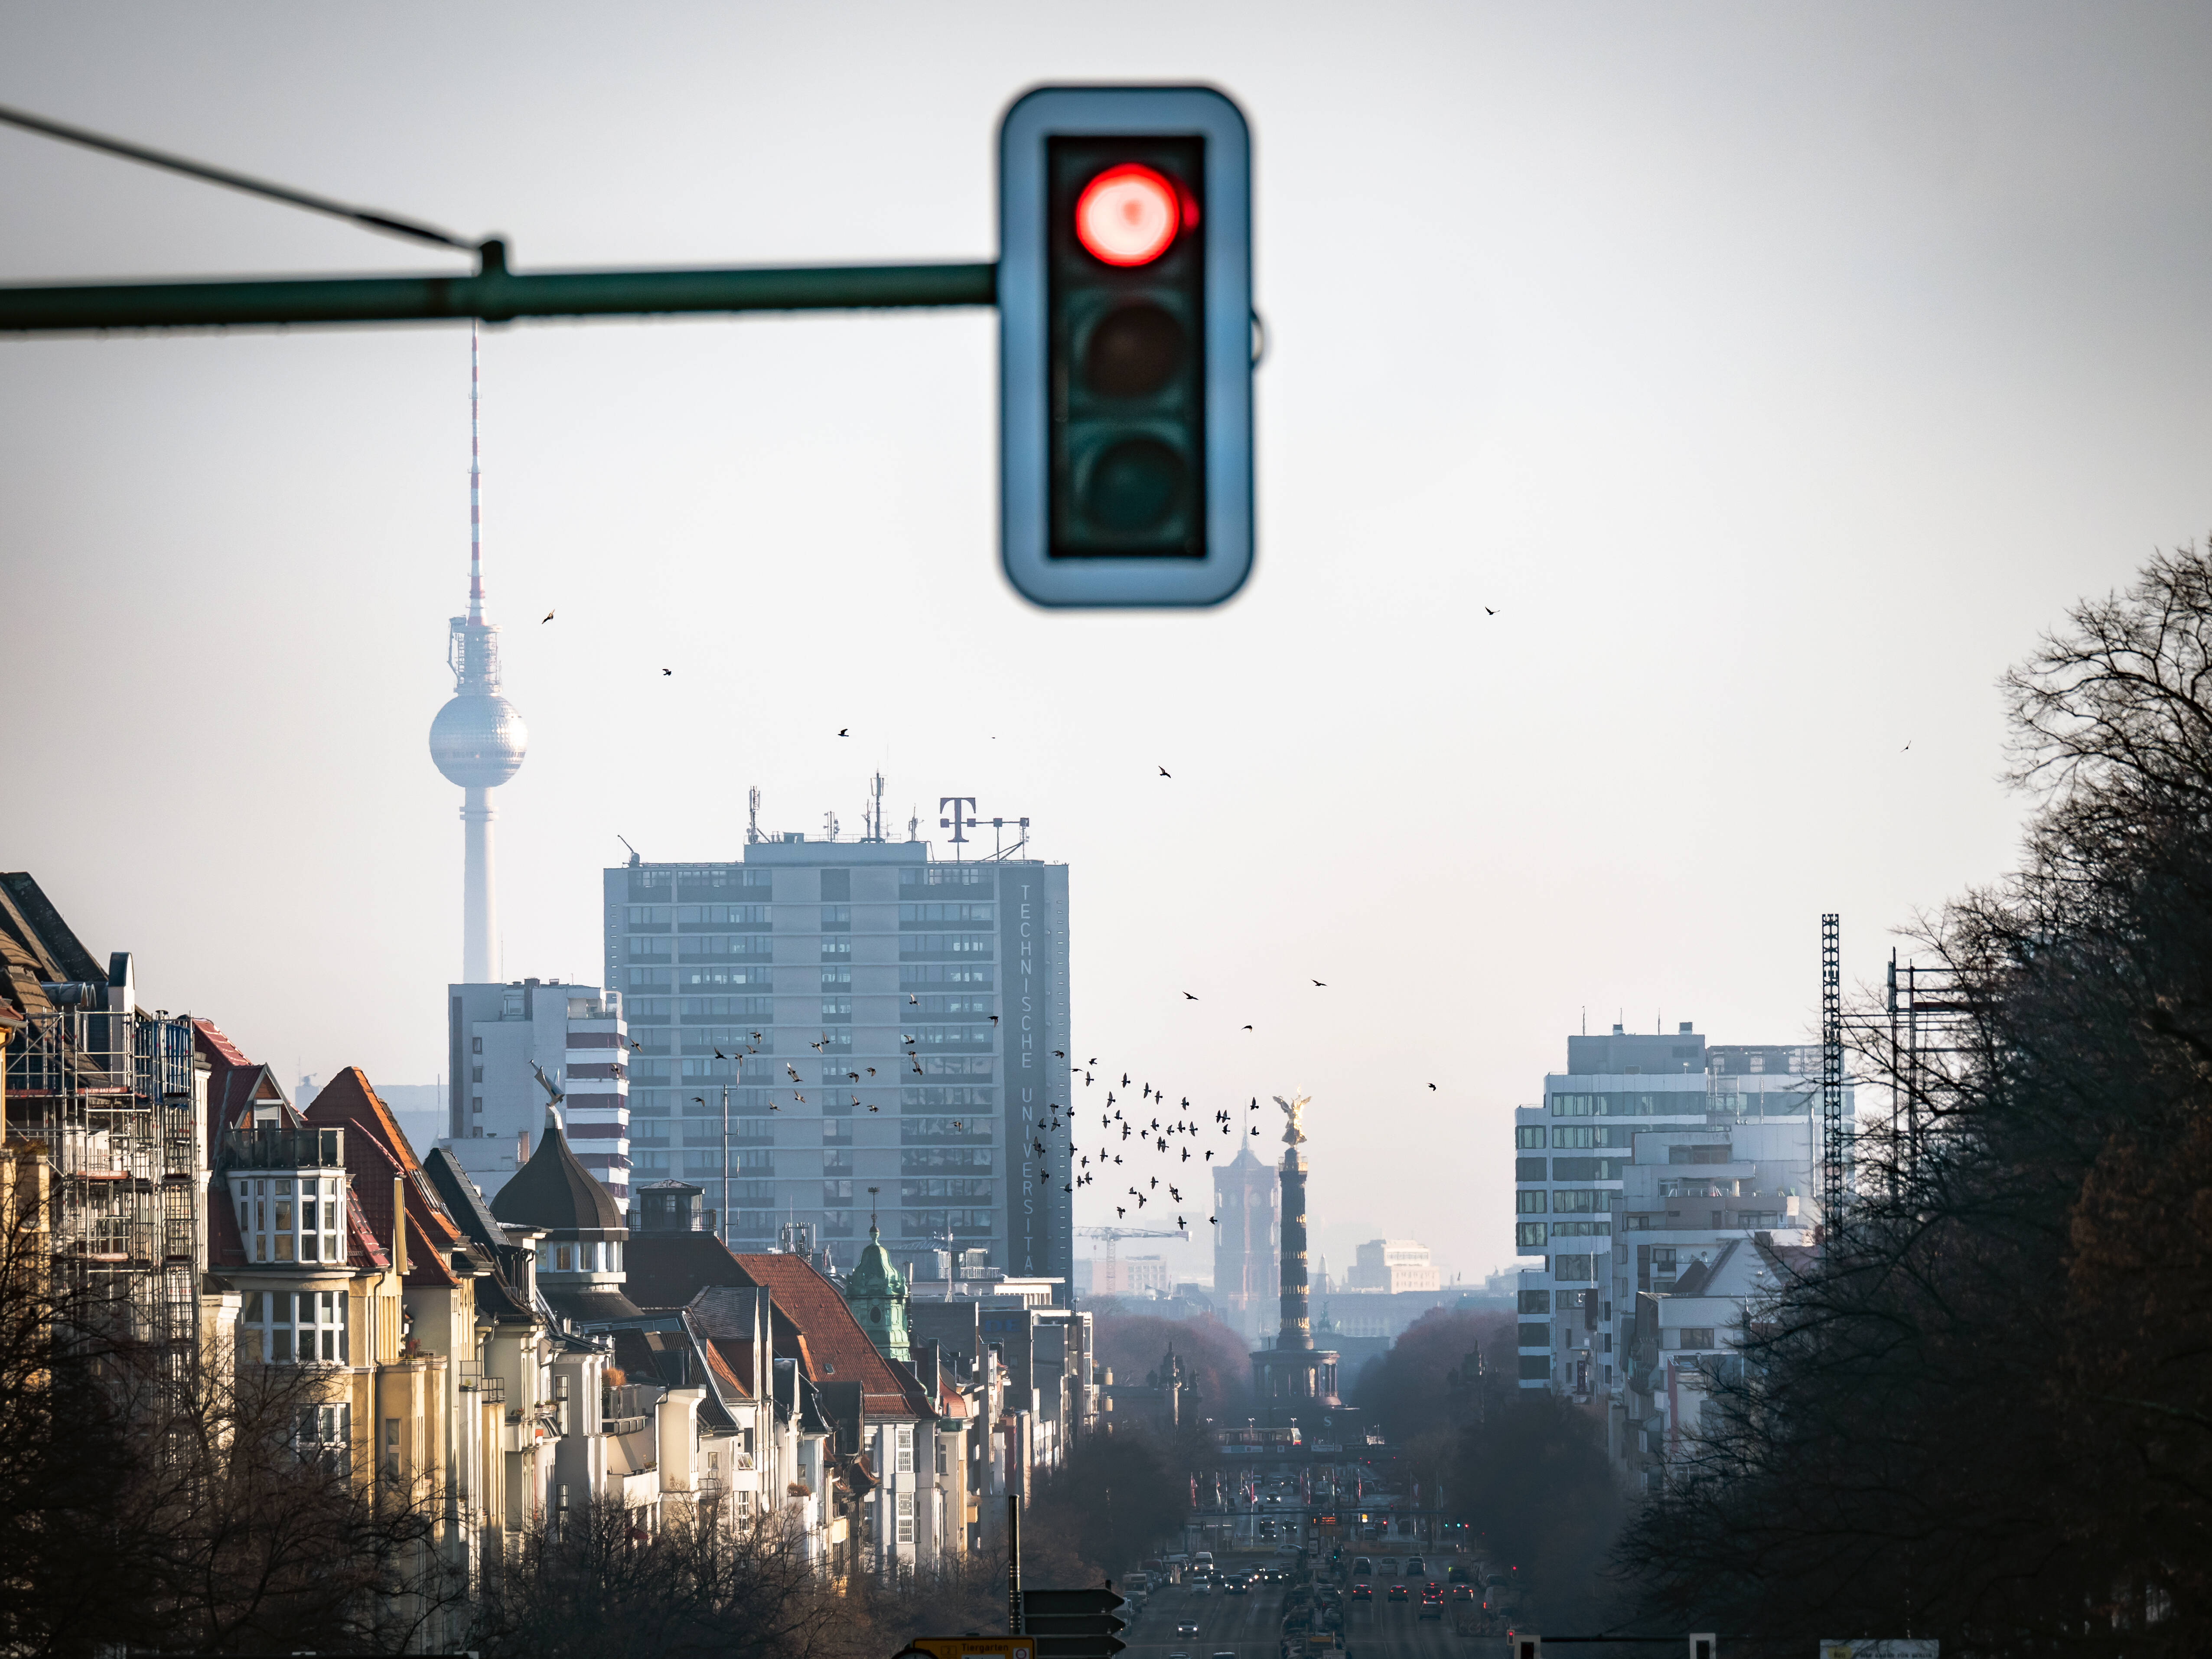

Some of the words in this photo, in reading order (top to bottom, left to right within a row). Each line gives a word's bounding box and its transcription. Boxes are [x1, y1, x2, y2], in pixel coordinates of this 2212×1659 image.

[940, 798, 976, 842] T
[1021, 885, 1032, 1068] TECHNISCHE
[1022, 1088, 1033, 1277] UNIVERSITÄ
[1325, 1416, 1332, 1426] S
[961, 1643, 1008, 1654] Tiergarten
